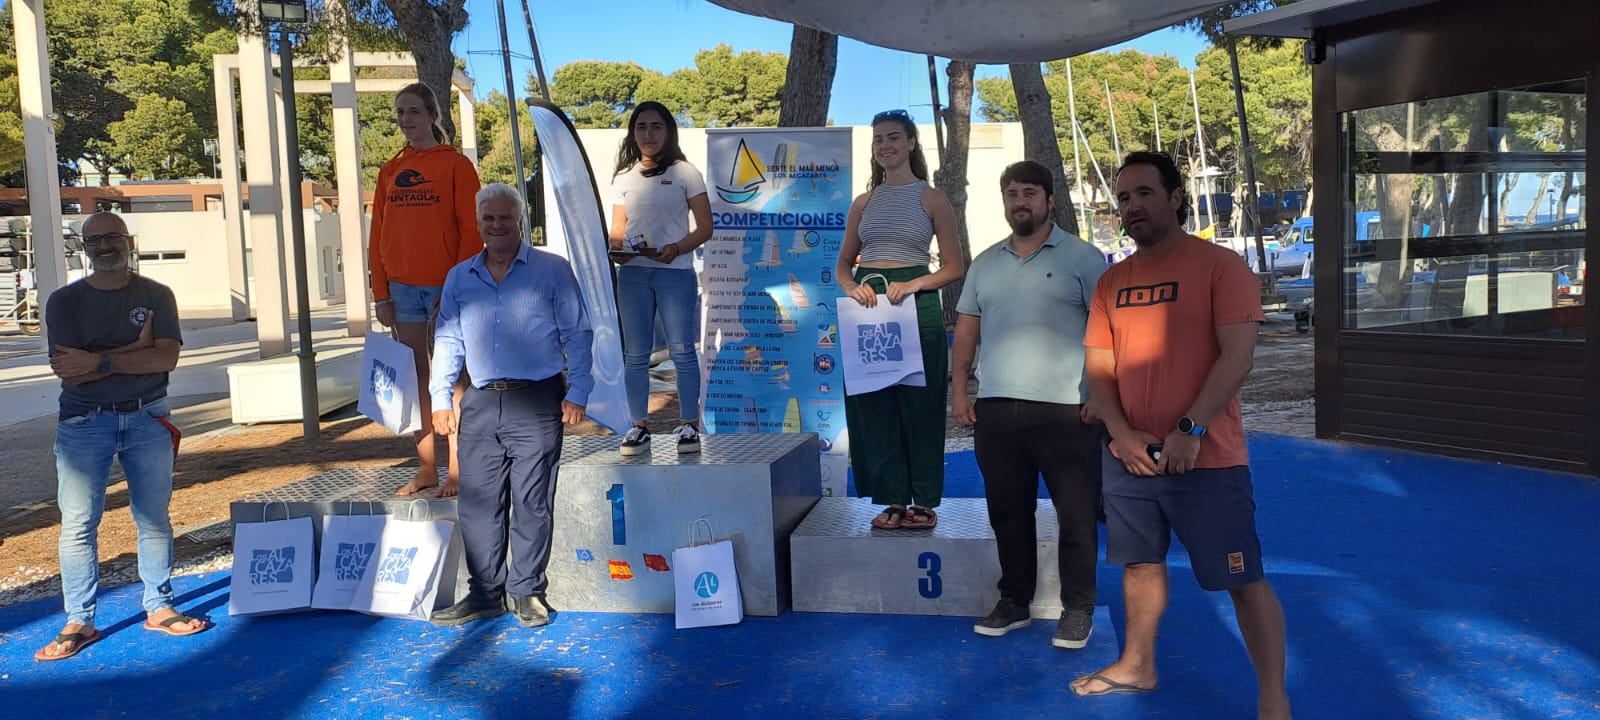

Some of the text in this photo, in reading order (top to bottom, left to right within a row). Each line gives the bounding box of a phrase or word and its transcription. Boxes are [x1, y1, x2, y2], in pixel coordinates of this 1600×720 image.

[767, 165, 787, 173] SIENTE
[816, 164, 840, 172] MENOR
[712, 212, 845, 226] COMPETICIONES
[860, 349, 888, 364] RES
[606, 484, 626, 545] 1
[336, 567, 360, 581] RES
[917, 551, 942, 599] 3
